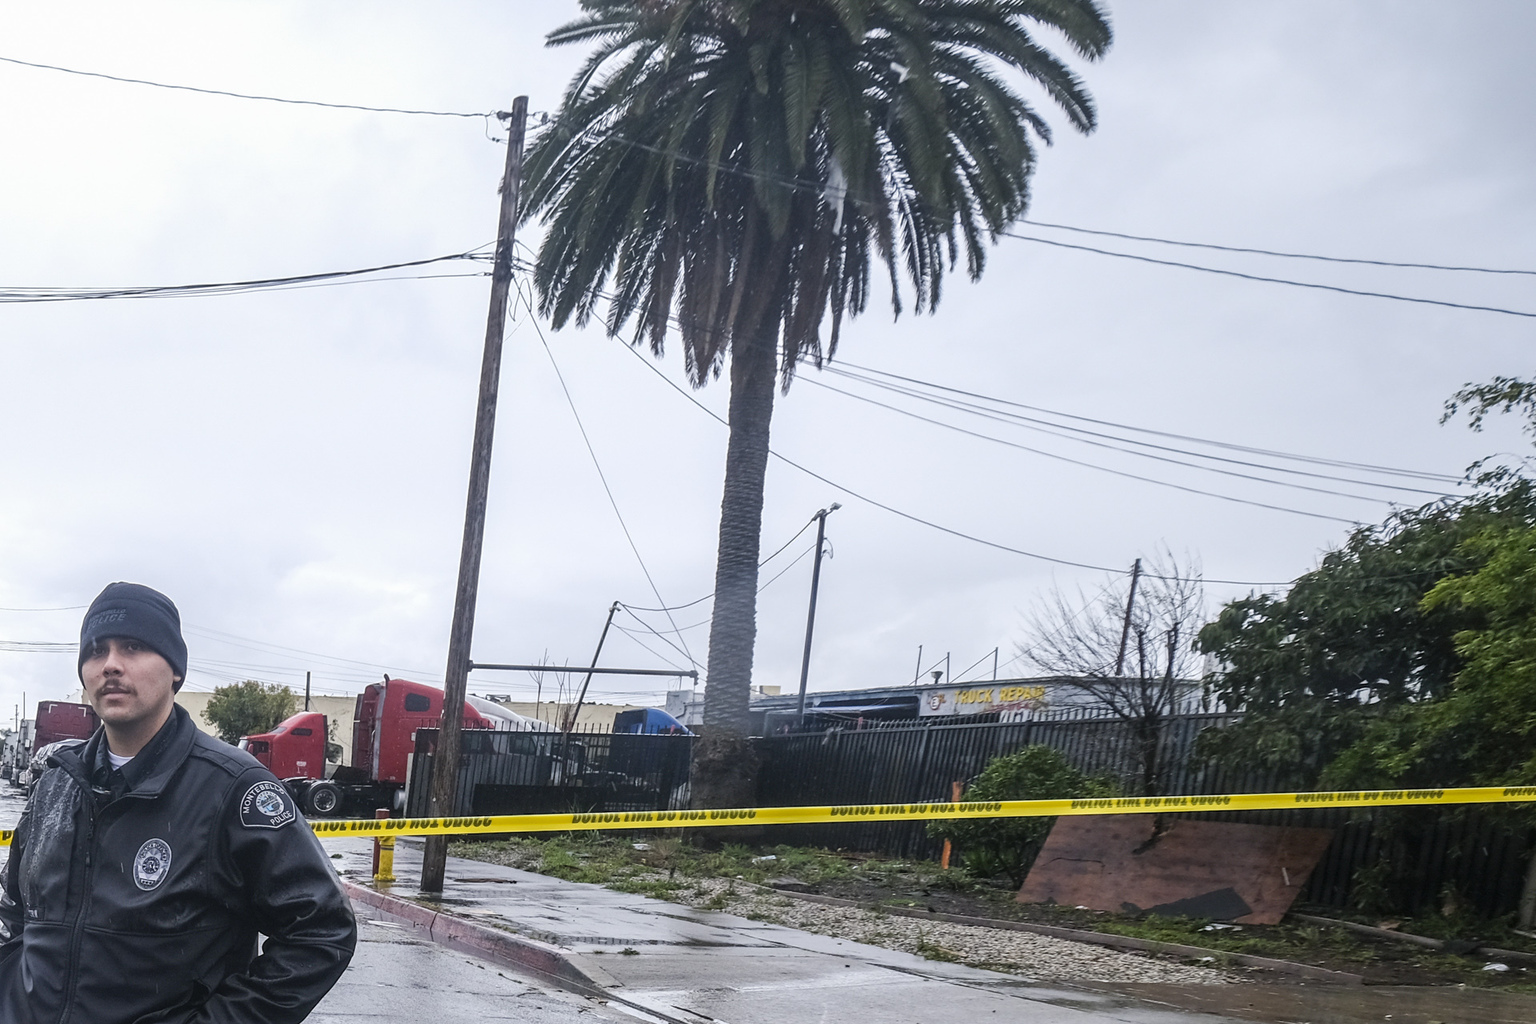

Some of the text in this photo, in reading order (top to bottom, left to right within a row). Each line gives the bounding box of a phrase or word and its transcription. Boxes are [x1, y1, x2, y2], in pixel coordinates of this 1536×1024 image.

[954, 689, 994, 704] TRUCK
[999, 685, 1046, 702] REPAIR
[243, 783, 285, 814] MONTEBELLO
[270, 810, 293, 826] POLICE
[311, 820, 347, 832] OLICE
